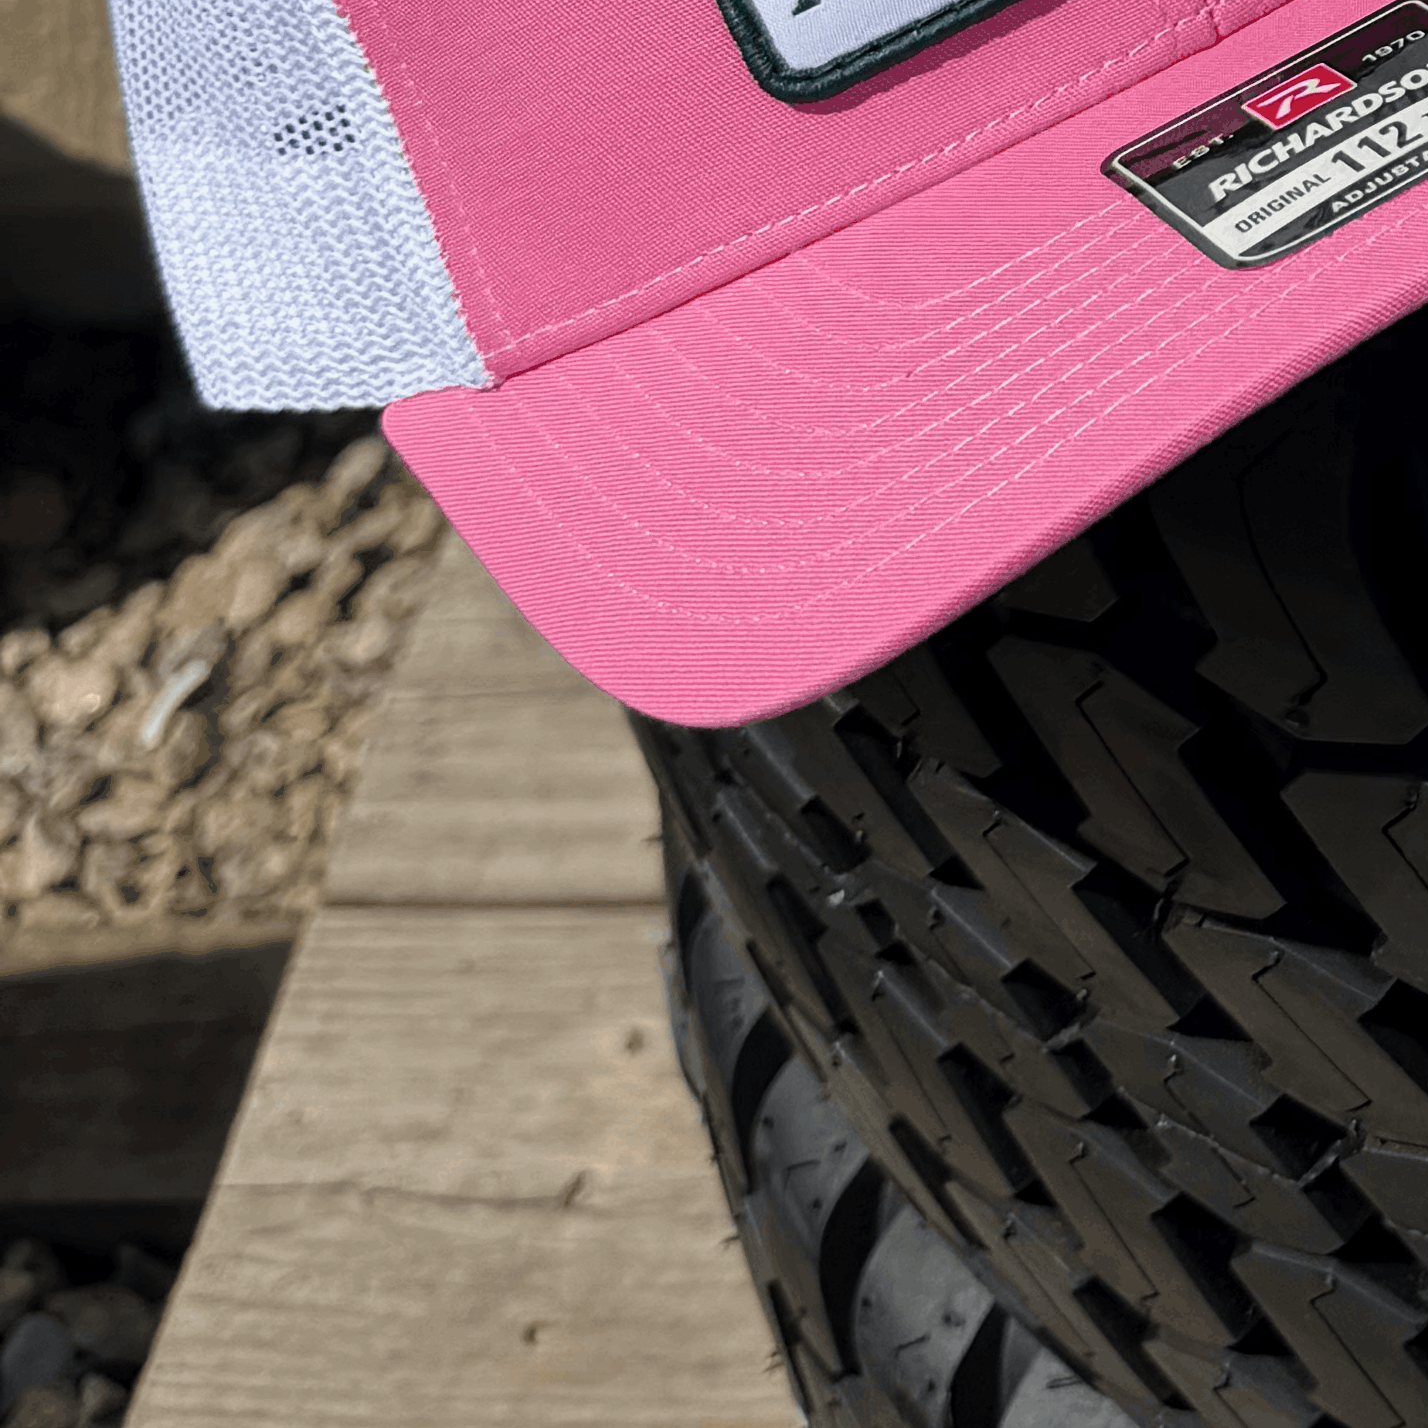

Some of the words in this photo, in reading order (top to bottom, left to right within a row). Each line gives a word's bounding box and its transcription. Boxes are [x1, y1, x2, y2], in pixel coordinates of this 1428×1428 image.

[1172, 132, 1235, 171] EST.
[1361, 30, 1426, 64] 1970
[1235, 171, 1331, 235] ORIGINAL
[1331, 119, 1426, 174] 112
